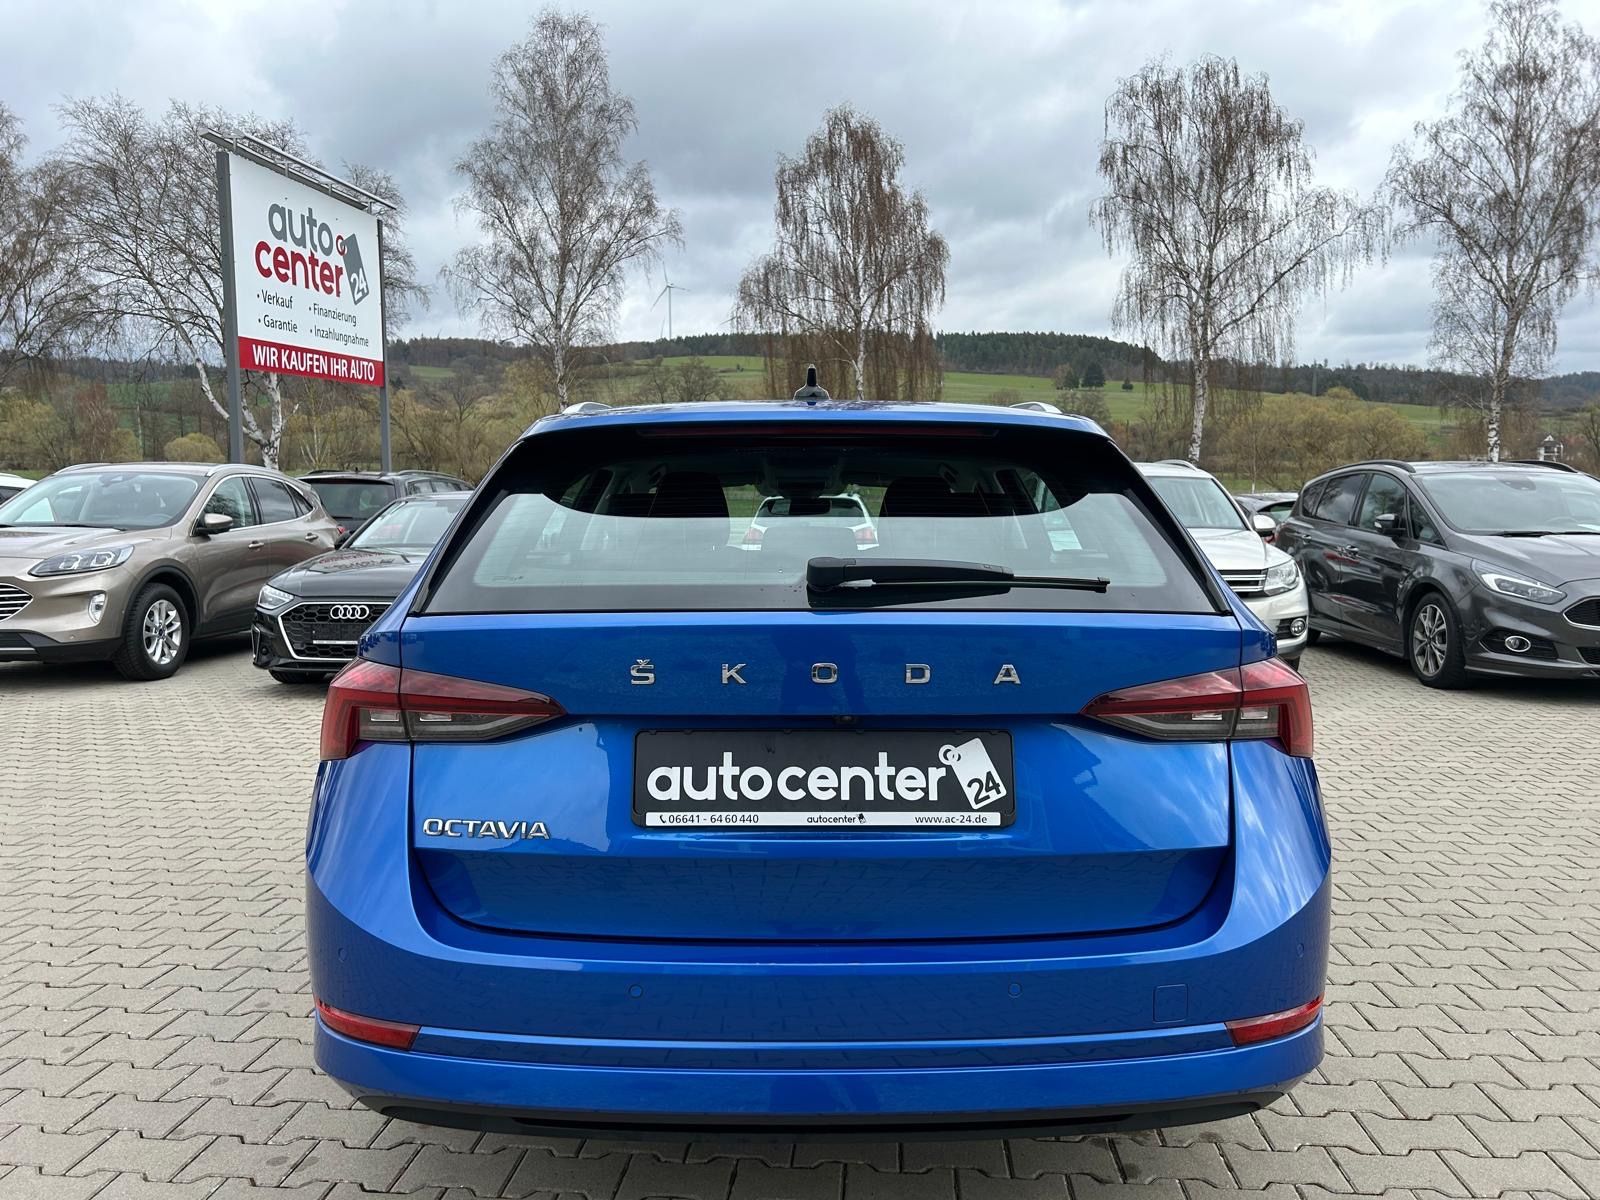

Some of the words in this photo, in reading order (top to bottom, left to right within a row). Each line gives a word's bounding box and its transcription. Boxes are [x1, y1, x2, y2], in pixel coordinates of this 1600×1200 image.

[268, 202, 334, 256] auto
[254, 240, 344, 298] center
[350, 267, 368, 300] 24
[261, 289, 294, 309] Verkauf
[263, 314, 298, 333] Garantie
[313, 303, 357, 327] Finanzierung
[314, 325, 369, 347] Inzahlungnahme
[252, 343, 279, 368] WIR
[281, 348, 328, 375] KAUFEN
[330, 357, 349, 378] IHR
[349, 359, 375, 382] AUTO
[967, 770, 1002, 805] 24
[423, 818, 550, 840] OCTAVIA
[668, 814, 700, 824] 06641
[806, 814, 856, 824] autocenter
[914, 814, 988, 824] www.ac-24.de
